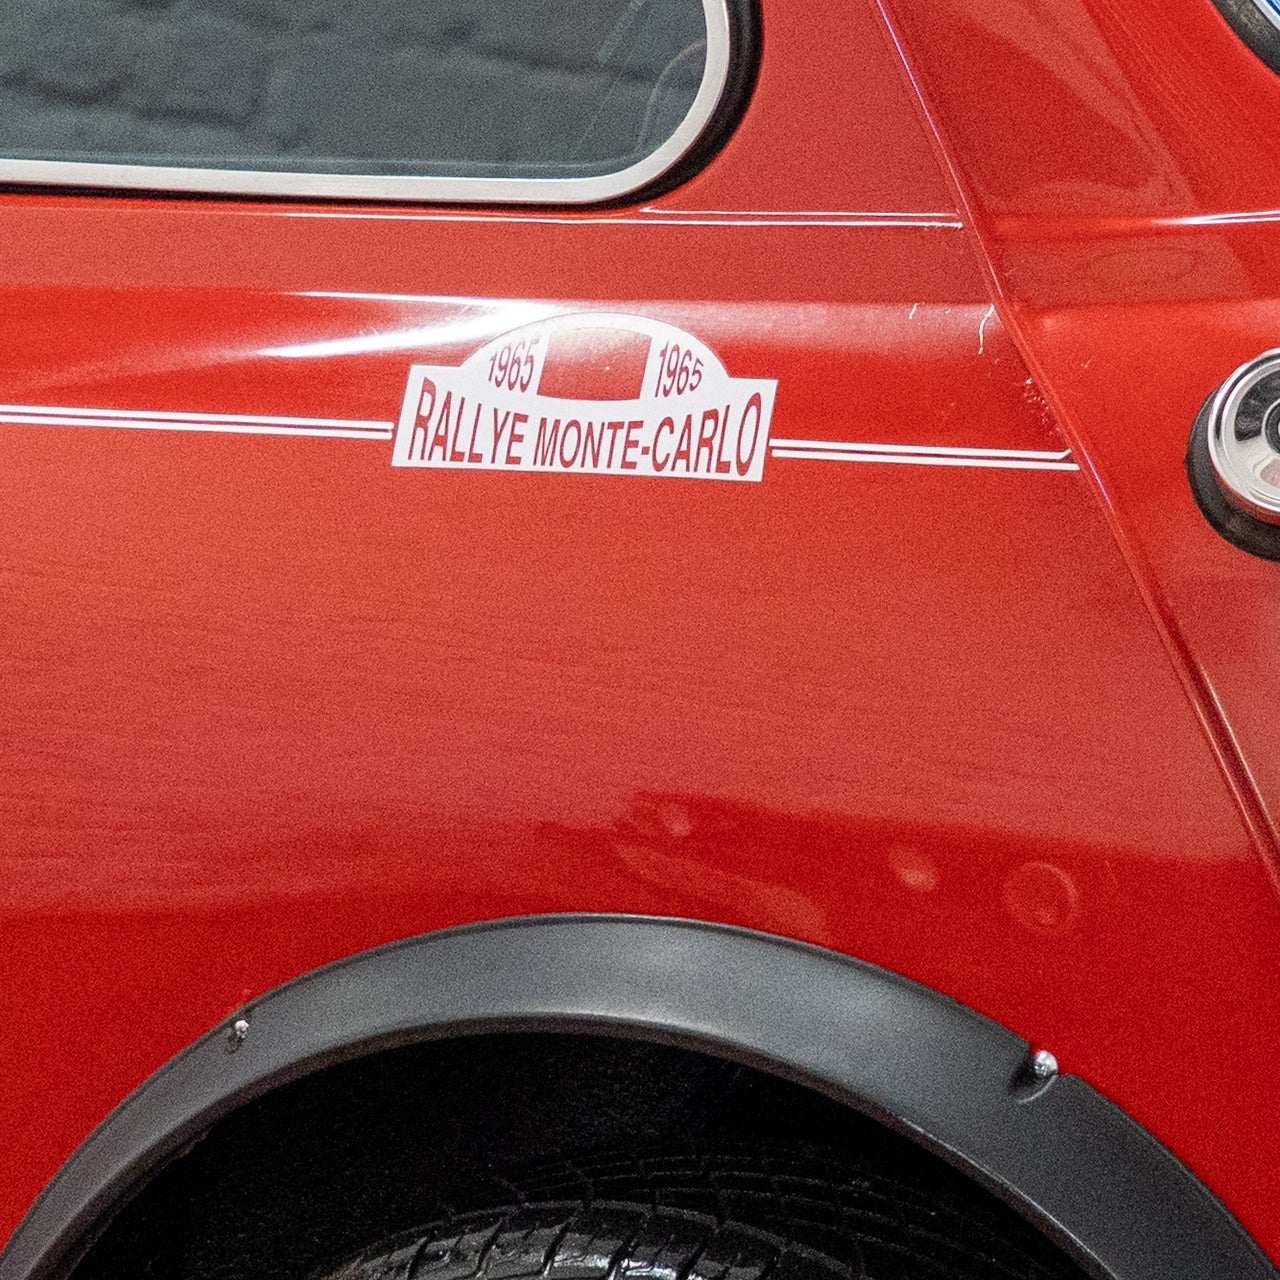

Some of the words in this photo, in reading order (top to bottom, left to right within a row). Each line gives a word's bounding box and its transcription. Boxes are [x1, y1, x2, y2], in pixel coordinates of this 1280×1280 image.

[488, 335, 539, 393] 1965
[655, 341, 704, 398] 1965
[408, 377, 528, 465] RALLYE
[533, 392, 762, 477] MONTE-CARLO
